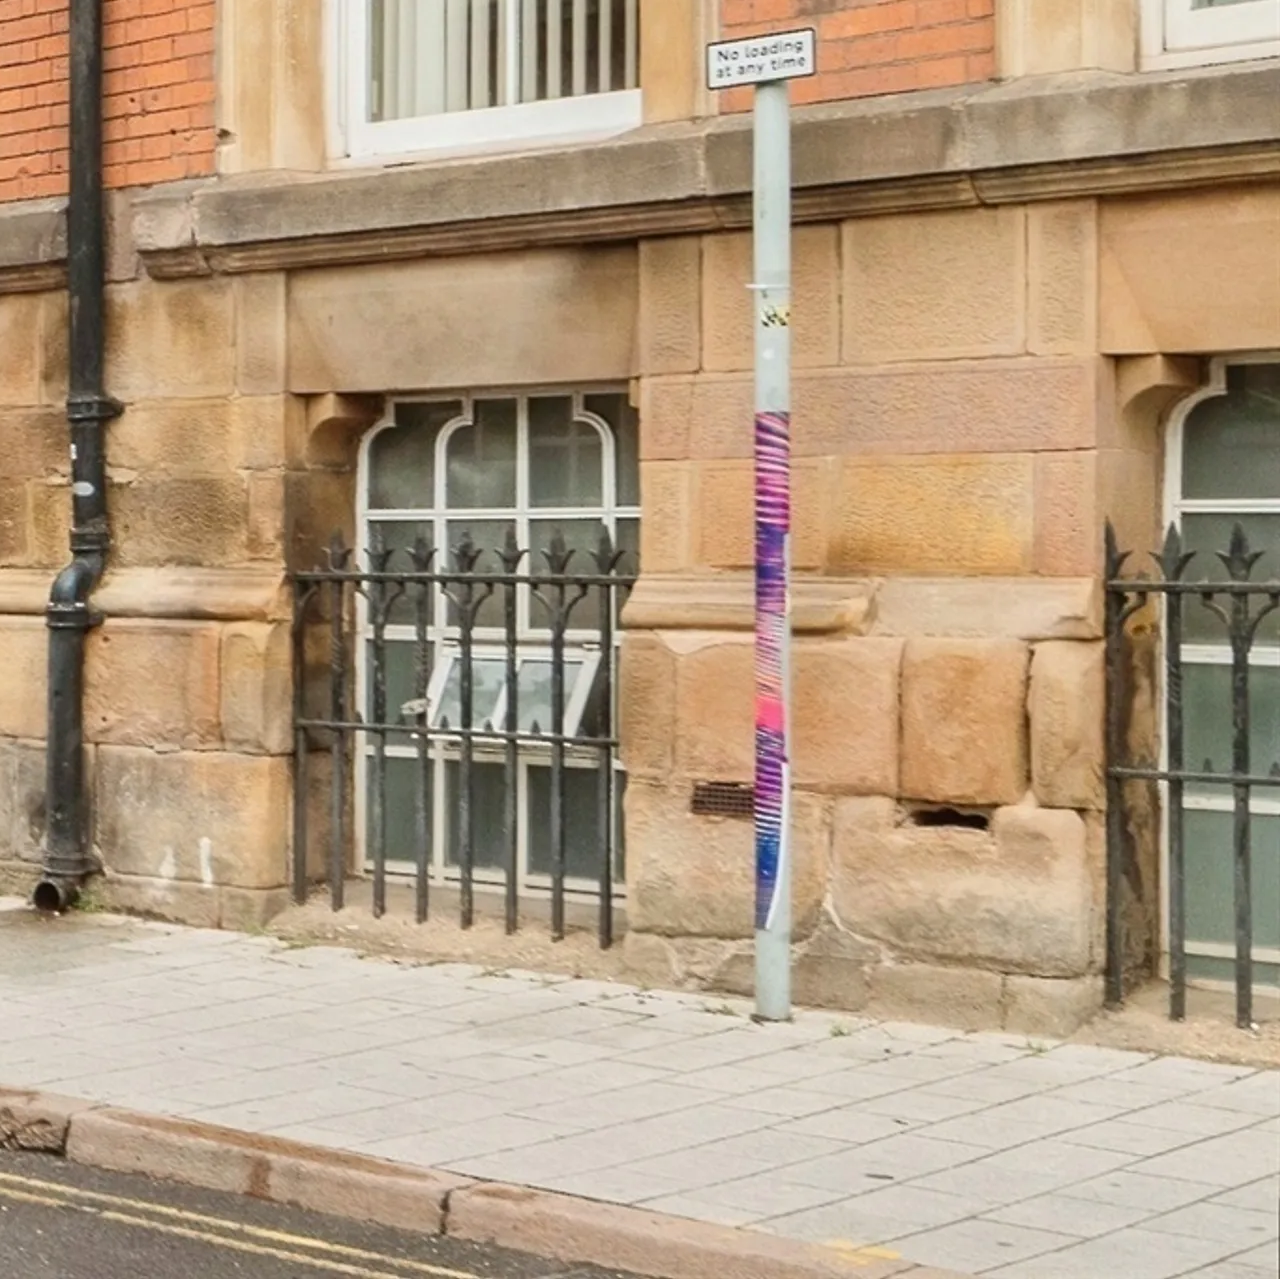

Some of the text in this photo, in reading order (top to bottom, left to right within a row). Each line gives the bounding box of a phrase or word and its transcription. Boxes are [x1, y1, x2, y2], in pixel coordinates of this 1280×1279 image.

[717, 40, 804, 62] No loading
[716, 56, 806, 79] at any time
